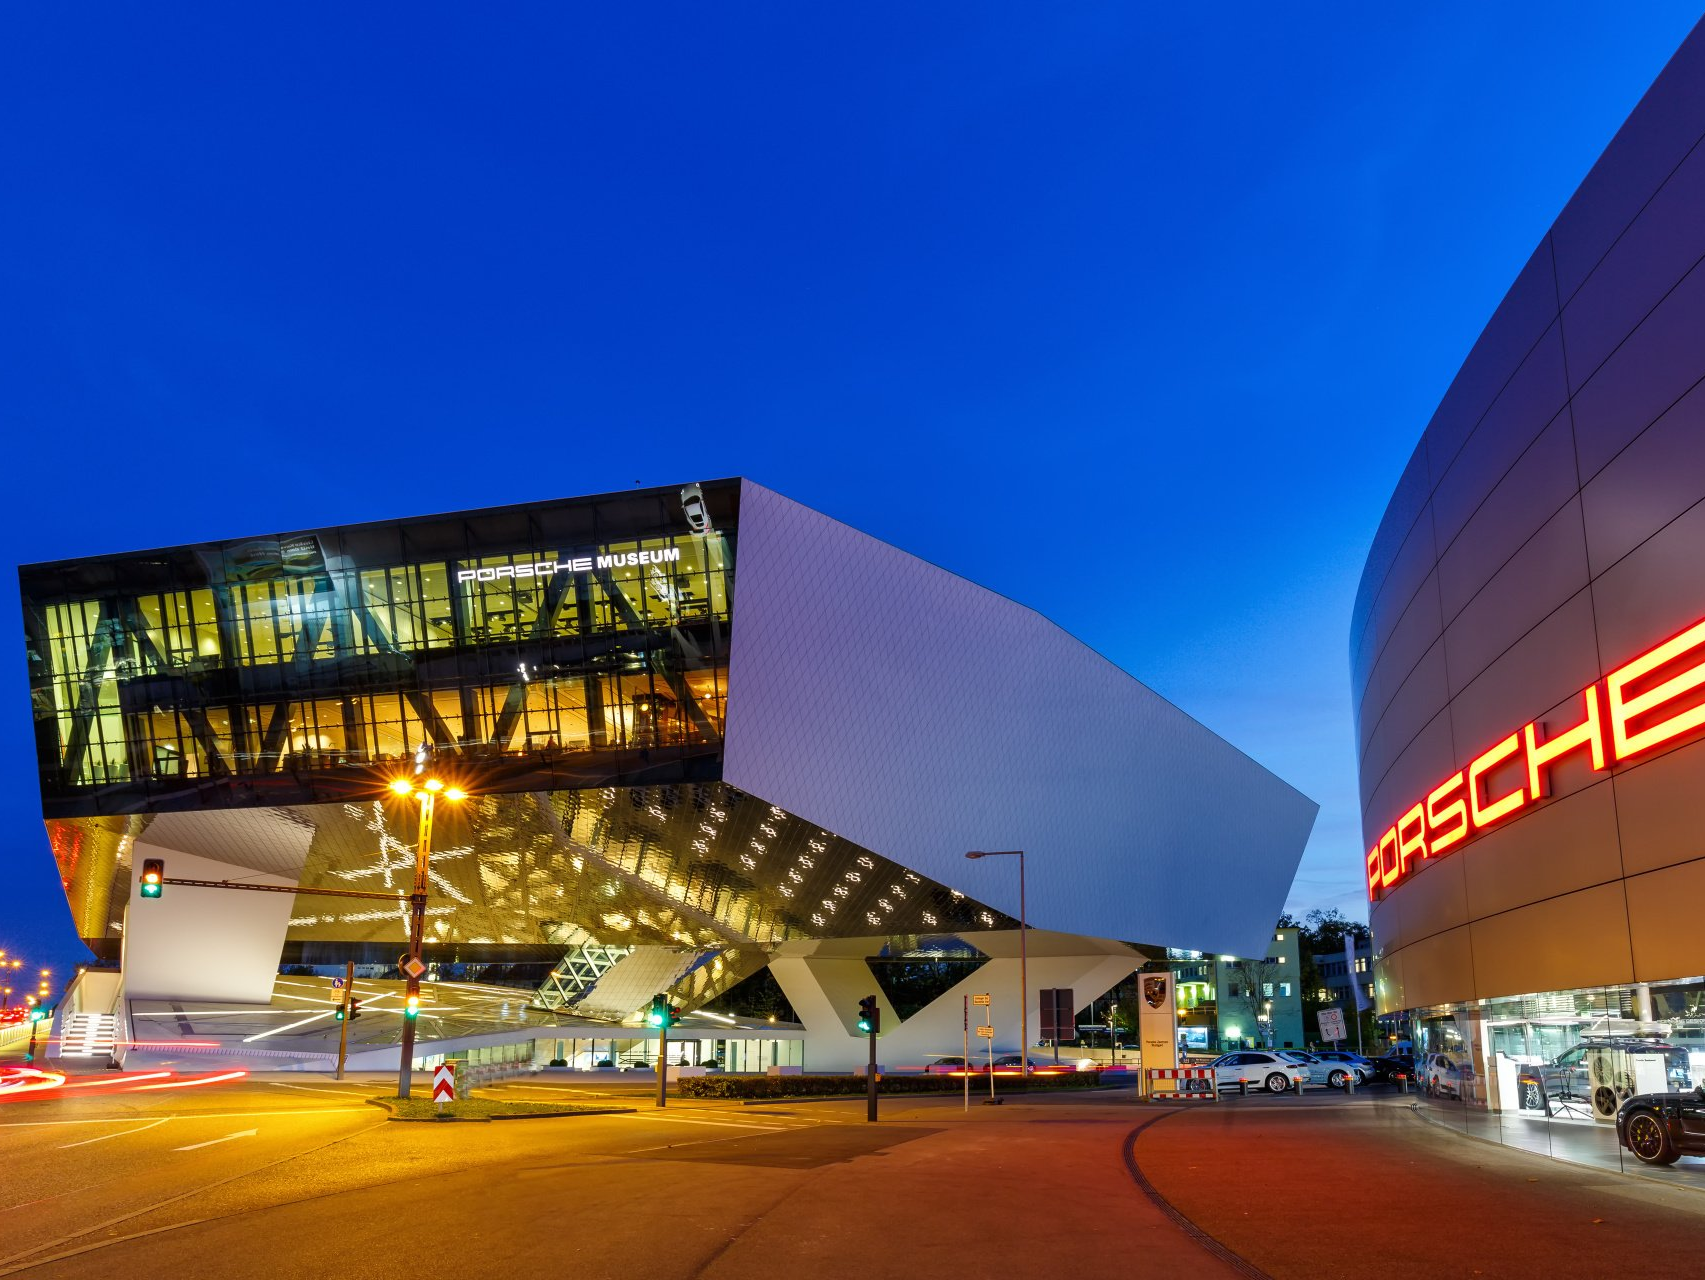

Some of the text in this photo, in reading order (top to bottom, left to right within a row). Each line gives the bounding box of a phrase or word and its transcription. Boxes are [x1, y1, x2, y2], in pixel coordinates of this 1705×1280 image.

[457, 547, 680, 584] PORSCHE MUSEUM
[1366, 617, 1705, 901] PORSCHE
